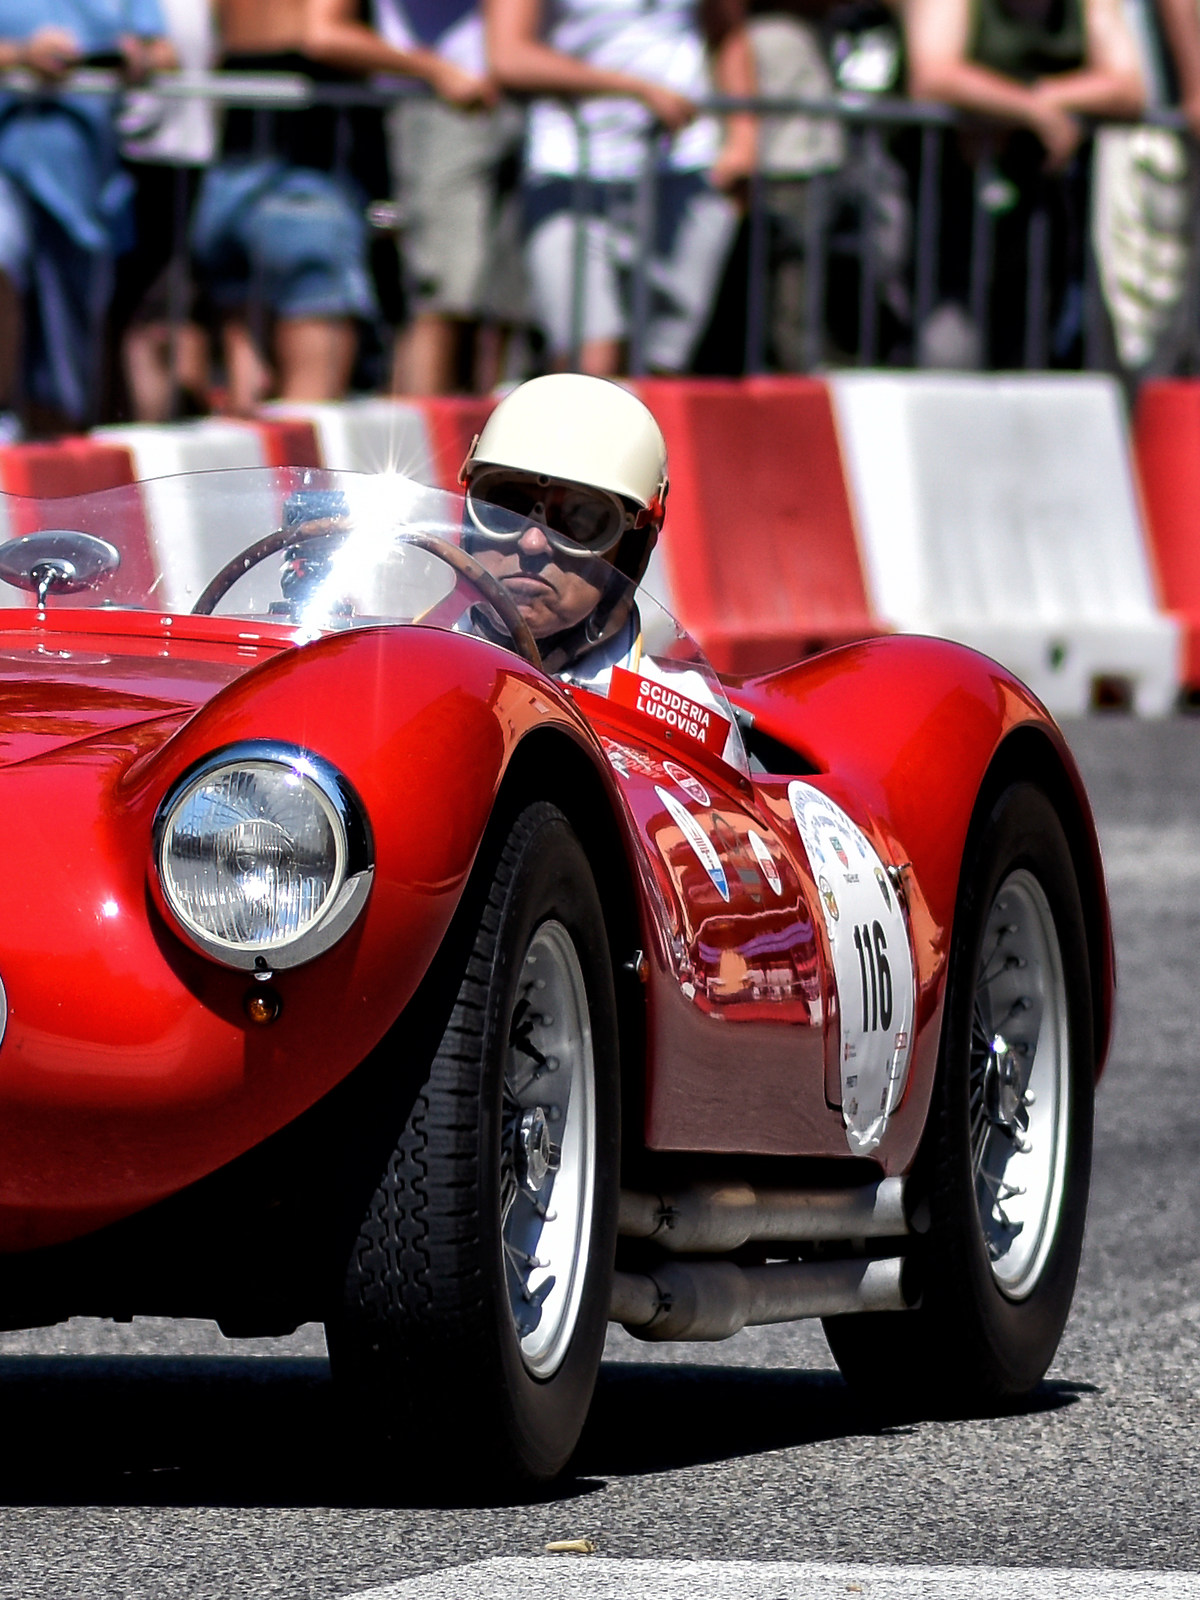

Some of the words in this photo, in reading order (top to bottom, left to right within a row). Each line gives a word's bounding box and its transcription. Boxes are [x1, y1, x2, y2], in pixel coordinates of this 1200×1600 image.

[636, 696, 706, 744] LUDOVISA
[640, 681, 710, 728] SCUDERIA
[853, 919, 893, 1033] 116
